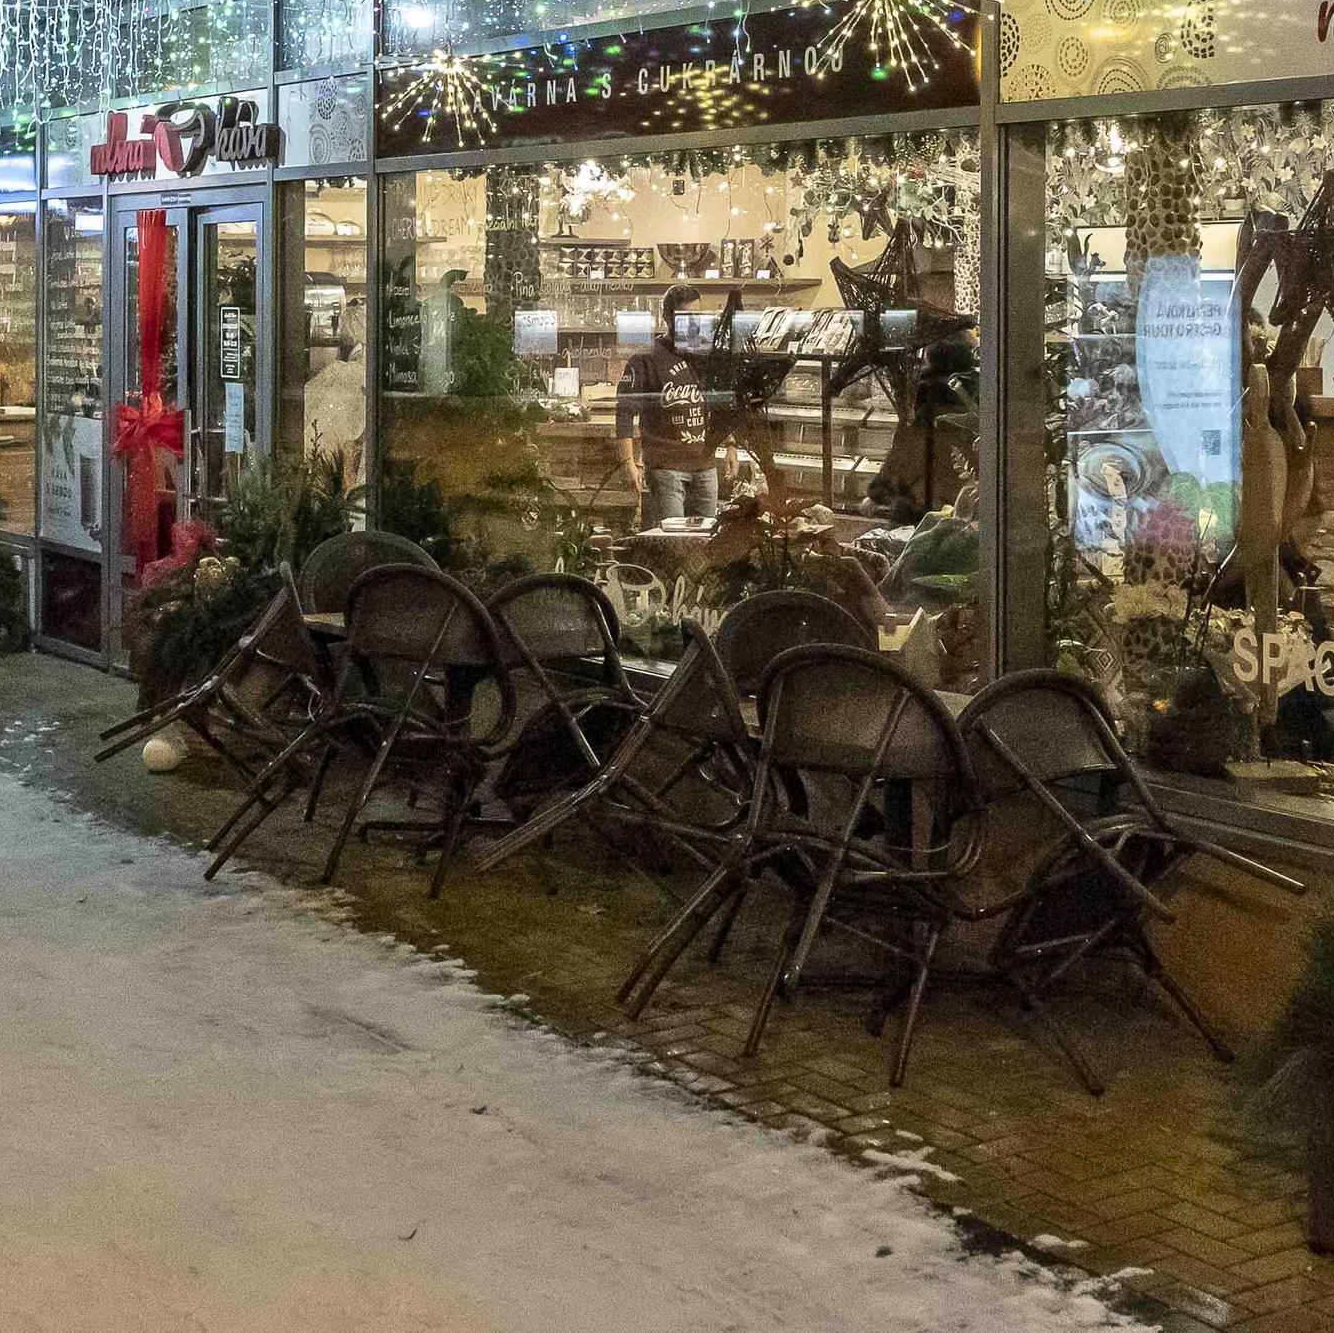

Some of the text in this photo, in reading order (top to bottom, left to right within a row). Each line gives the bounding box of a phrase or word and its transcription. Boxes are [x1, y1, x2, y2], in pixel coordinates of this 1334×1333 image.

[471, 46, 844, 114] AVÁRNA S CUKRÁRNOU
